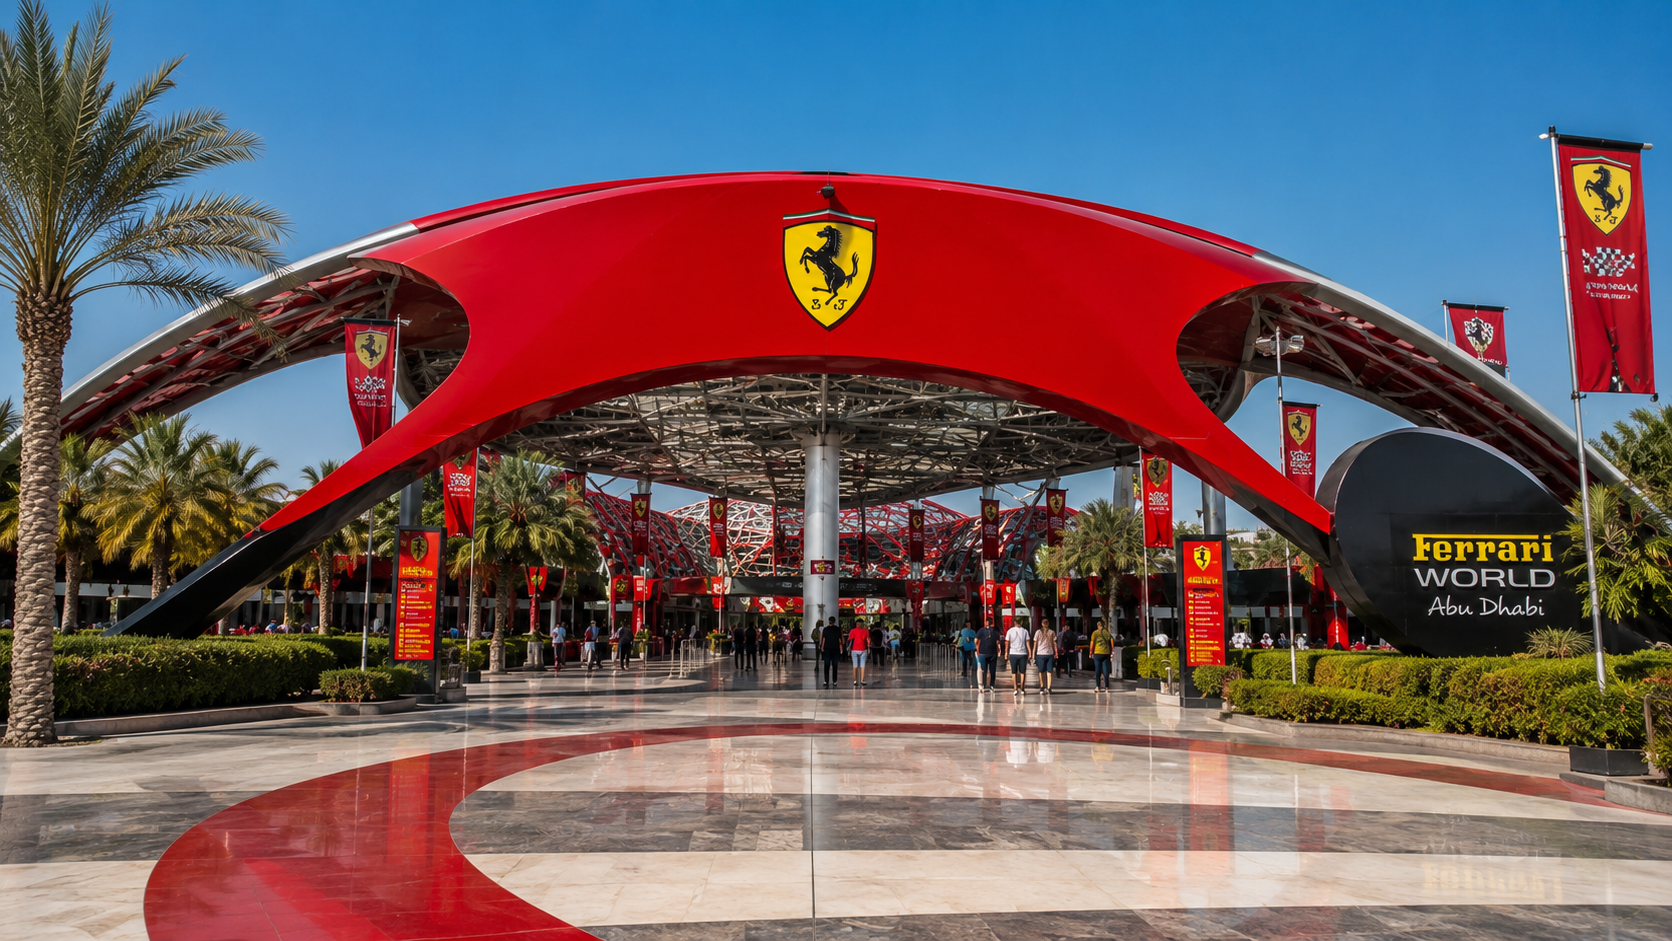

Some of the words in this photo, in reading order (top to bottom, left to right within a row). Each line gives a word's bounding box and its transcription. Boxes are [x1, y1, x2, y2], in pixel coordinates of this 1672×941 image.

[1412, 533, 1554, 562] Ferrari
[1413, 568, 1556, 588] WORLD
[1428, 595, 1473, 616] Abu
[1479, 595, 1545, 616] Dhabi
